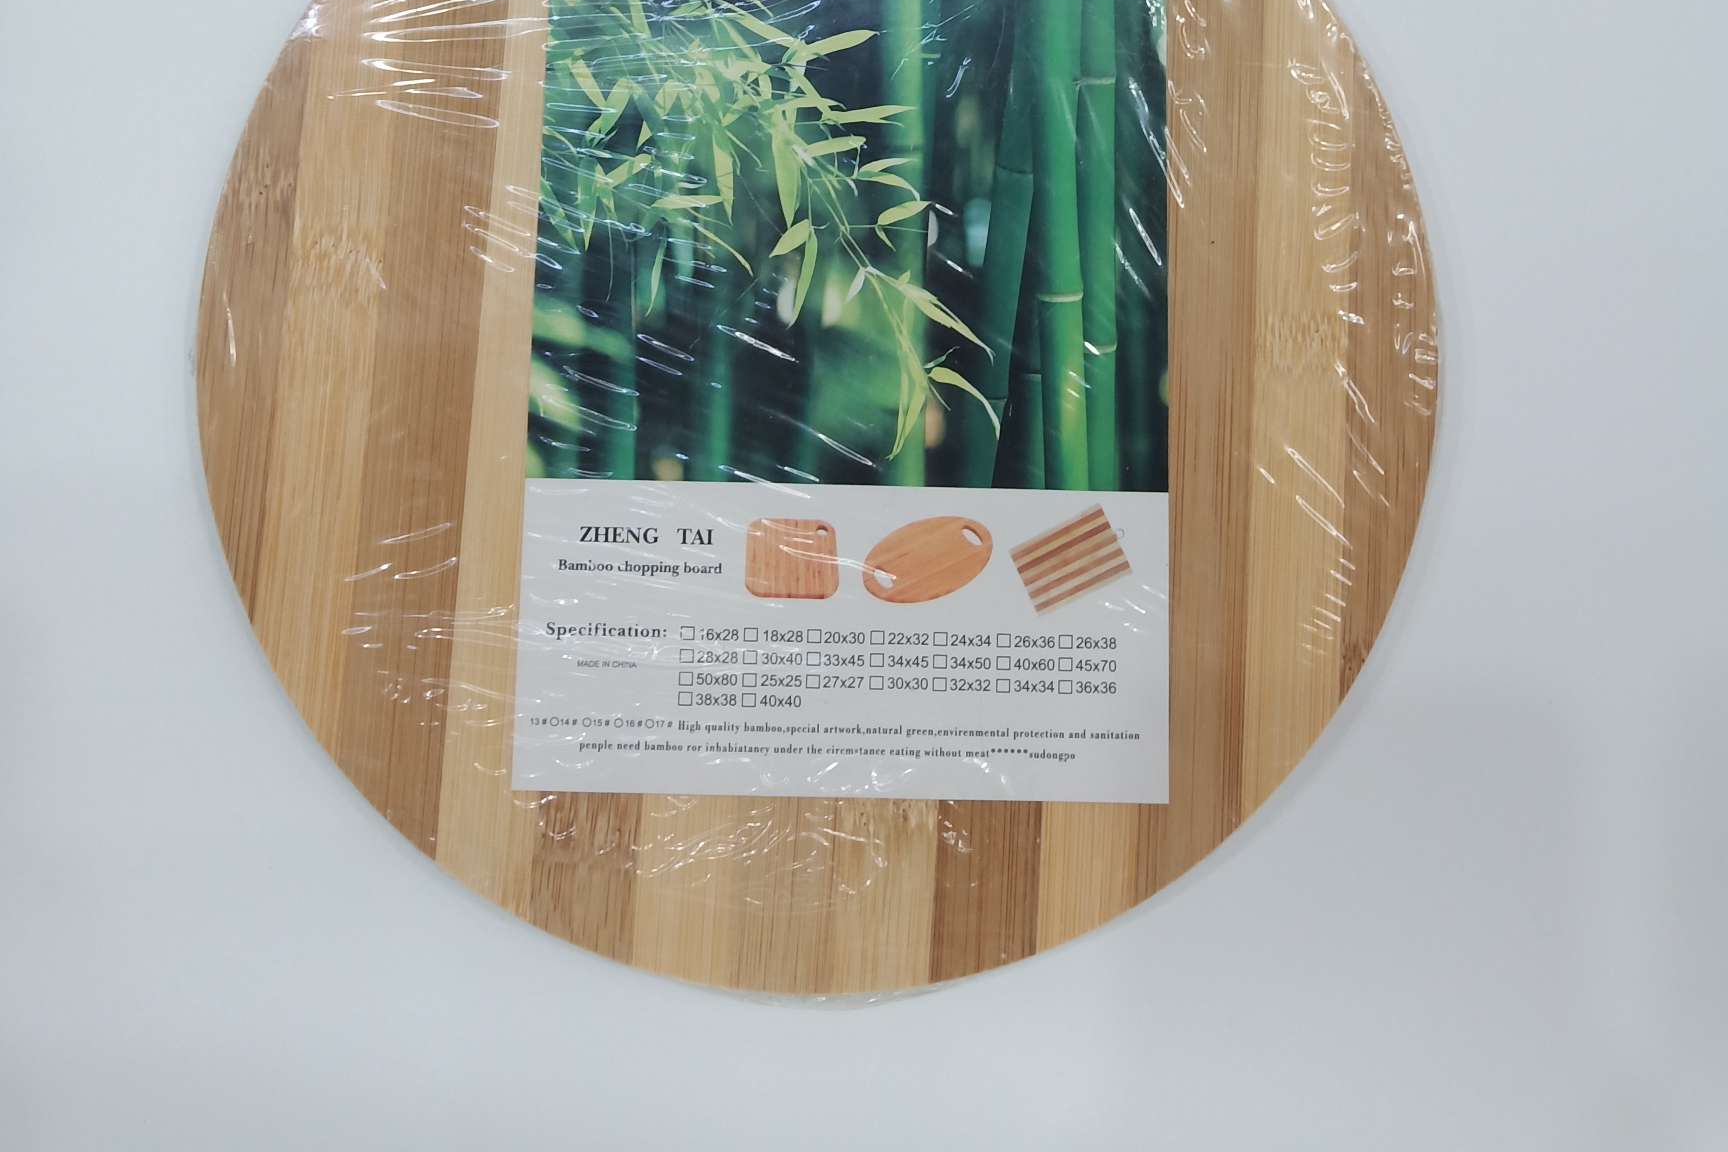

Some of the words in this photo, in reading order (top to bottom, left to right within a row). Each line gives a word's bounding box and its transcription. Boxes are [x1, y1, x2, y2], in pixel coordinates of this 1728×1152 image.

[579, 526, 659, 544] ZHENG
[677, 528, 714, 545] TAI
[618, 560, 680, 577] chopping
[684, 562, 722, 575] board
[546, 622, 667, 640] Specification:
[763, 630, 803, 643] 18x28
[824, 631, 865, 644] 20x30
[888, 632, 929, 648] 22x32
[951, 634, 992, 647] 24x34
[1014, 635, 1055, 648] 26x36
[1076, 637, 1117, 649] 26x38
[577, 660, 599, 668] MADE
[697, 651, 738, 664] 28x28
[762, 652, 802, 665] 30x40
[824, 654, 864, 667] 33x45
[888, 655, 929, 668] 34x45
[950, 657, 991, 670] 34x50
[1014, 658, 1055, 672] 40x60
[1075, 659, 1116, 672] 45x70
[696, 673, 737, 686] 50x80
[760, 674, 802, 687] 25x25
[823, 676, 864, 688] 27x27
[888, 677, 928, 690] 30x30
[950, 679, 991, 692] 32x32
[1014, 680, 1054, 696] 34x34
[1076, 680, 1117, 696] 36x36
[696, 693, 737, 706] 38x38
[760, 695, 801, 708] 40x40
[678, 720, 701, 733] High
[705, 721, 739, 734] quality
[1014, 729, 1064, 740] protection
[1068, 729, 1086, 739] and
[1091, 730, 1140, 740] sanitation
[617, 740, 640, 750] need
[645, 741, 683, 751] bamboo
[807, 744, 822, 754] the
[924, 747, 961, 757] without
